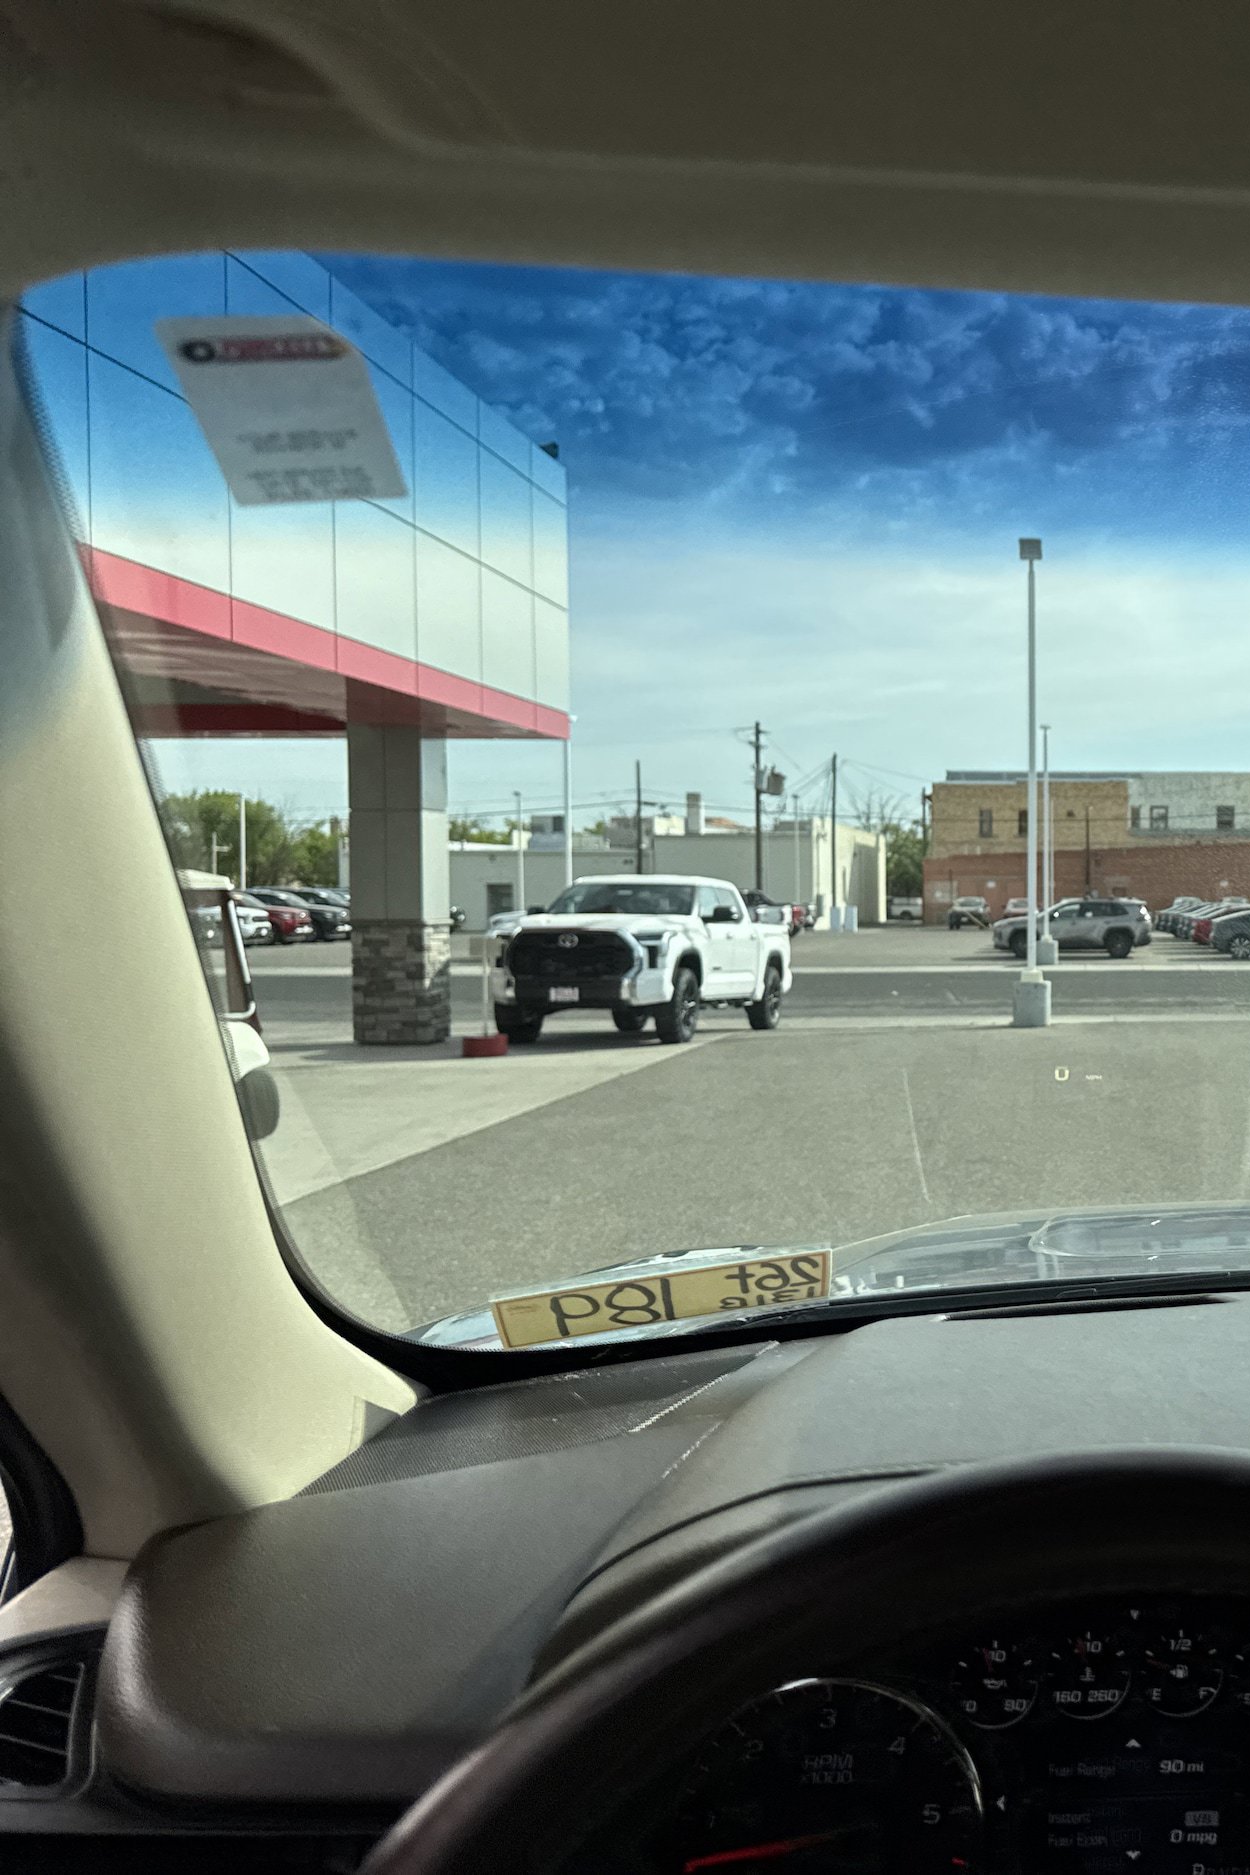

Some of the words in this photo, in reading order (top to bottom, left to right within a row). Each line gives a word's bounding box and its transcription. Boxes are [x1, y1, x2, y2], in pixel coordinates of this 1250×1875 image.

[1150, 1688, 1161, 1701] E
[820, 1709, 838, 1728] 3
[888, 1737, 906, 1755] 4
[1160, 1759, 1185, 1774] 90
[1187, 1761, 1205, 1773] mi
[921, 1804, 941, 1824] 5
[1170, 1828, 1184, 1844] 0
[1187, 1832, 1218, 1846] mpg
